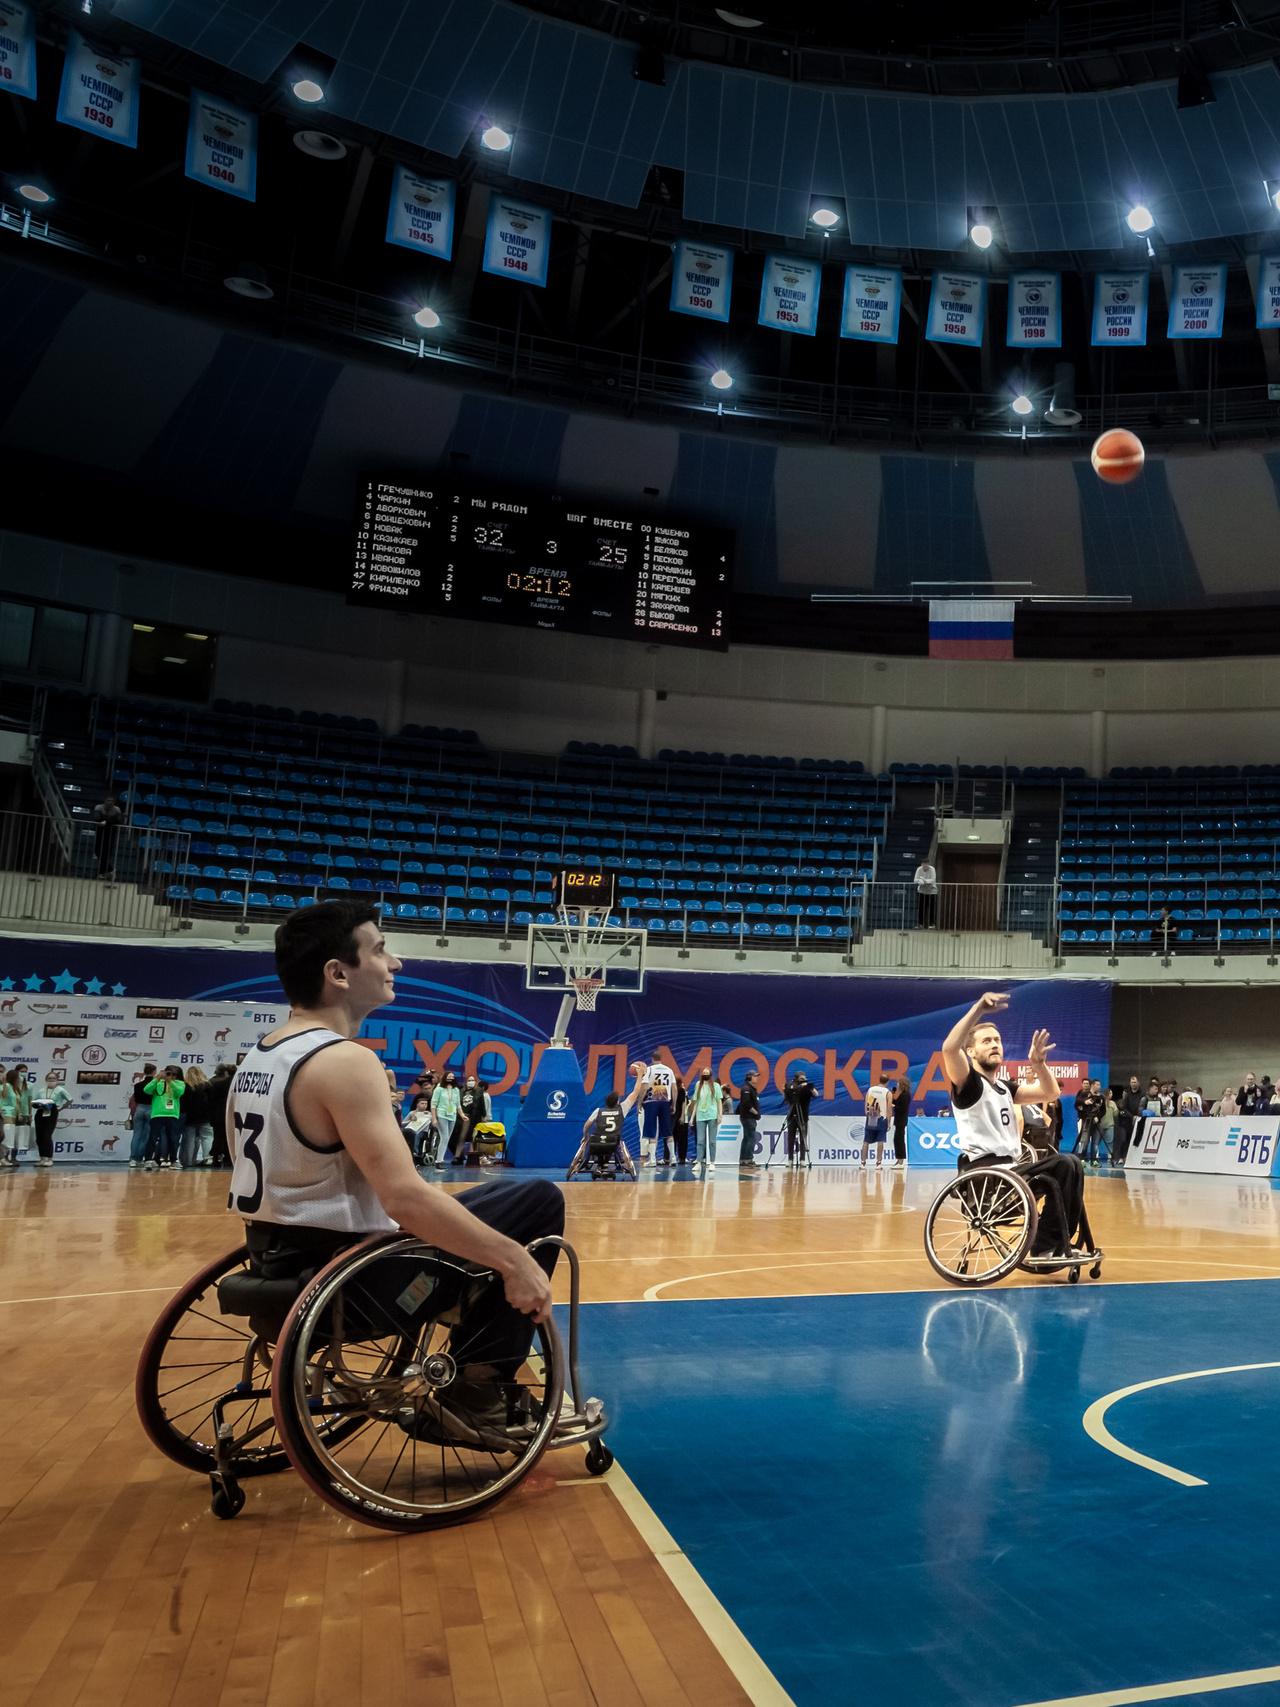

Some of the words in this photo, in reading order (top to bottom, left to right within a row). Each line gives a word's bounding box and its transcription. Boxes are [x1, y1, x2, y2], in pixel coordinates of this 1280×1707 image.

[81, 74, 124, 103] ЧЕМПИОН
[89, 92, 113, 112] СССР
[84, 106, 114, 128] 1939
[203, 134, 244, 160] ЧЕМПИОН
[212, 151, 234, 168] СССР
[207, 164, 235, 184] 1940
[404, 202, 442, 222] ЧЕМПИОН
[412, 218, 432, 231] СССР
[408, 228, 434, 244] 1945
[500, 231, 536, 250] ЧЕМПИОН
[506, 245, 527, 258] СССР
[503, 257, 528, 272] 1948
[686, 272, 720, 288] ЧЕМПИОН
[692, 284, 712, 297] СССР
[774, 286, 806, 302] ЧЕМПИОН
[688, 296, 712, 309] 1950
[779, 298, 798, 311] СССР
[856, 298, 888, 311] ЧЕМПИОН
[940, 300, 972, 314] ЧЕМПИОН
[1182, 298, 1213, 308] ЧЕМПИОН
[776, 310, 799, 323] 1953
[862, 310, 880, 320] СССР
[1018, 305, 1049, 316] ЧЕМПИОН
[1104, 304, 1136, 316] ЧЕМПИОН
[1184, 308, 1209, 319] РОССИИ
[946, 312, 964, 324] СССР
[1021, 316, 1046, 328] РОССИИ
[1106, 316, 1132, 326] РОССИИ
[860, 321, 881, 332] 1957
[944, 324, 966, 335] 1958
[1184, 320, 1208, 330] 2000
[1024, 328, 1046, 338] 1998
[1108, 328, 1130, 337] 1999
[376, 504, 426, 518] ДВОРКОВИЧ
[471, 498, 486, 508] МЫ
[492, 501, 528, 514] РЯДОМ
[567, 513, 587, 523] ШАГ
[593, 517, 633, 531] ВМЕСТЕ
[375, 524, 402, 534] НОВАК
[474, 527, 503, 546] 32
[373, 544, 411, 555] ПАНКОВА
[546, 540, 557, 554] 3
[372, 554, 405, 564] ИВАНОВ
[600, 545, 627, 564] 25
[653, 555, 683, 565] ПЕСКОВ
[528, 566, 568, 579] ВРЕМЯ
[370, 574, 420, 586] КИРИЛЕНКО
[442, 583, 452, 591] 12
[507, 573, 571, 596] 02:12
[369, 584, 408, 595] ФРИДЗОН
[651, 593, 680, 602] МЯГКИХ
[650, 602, 689, 613] ЗАХАРОВА
[254, 1014, 276, 1023] ВТБ
[181, 1054, 204, 1064] ВТБ
[234, 1072, 274, 1097] ЮБЕРЦЫ
[654, 1074, 669, 1086] 33
[605, 1116, 616, 1132] 5
[55, 1142, 84, 1153] ВТБ
[1176, 1140, 1190, 1148] РФБ
[1238, 1135, 1272, 1164] ВТБ
[818, 1149, 897, 1160] ГАЗПРОБНК
[298, 1283, 320, 1316] KENDA
